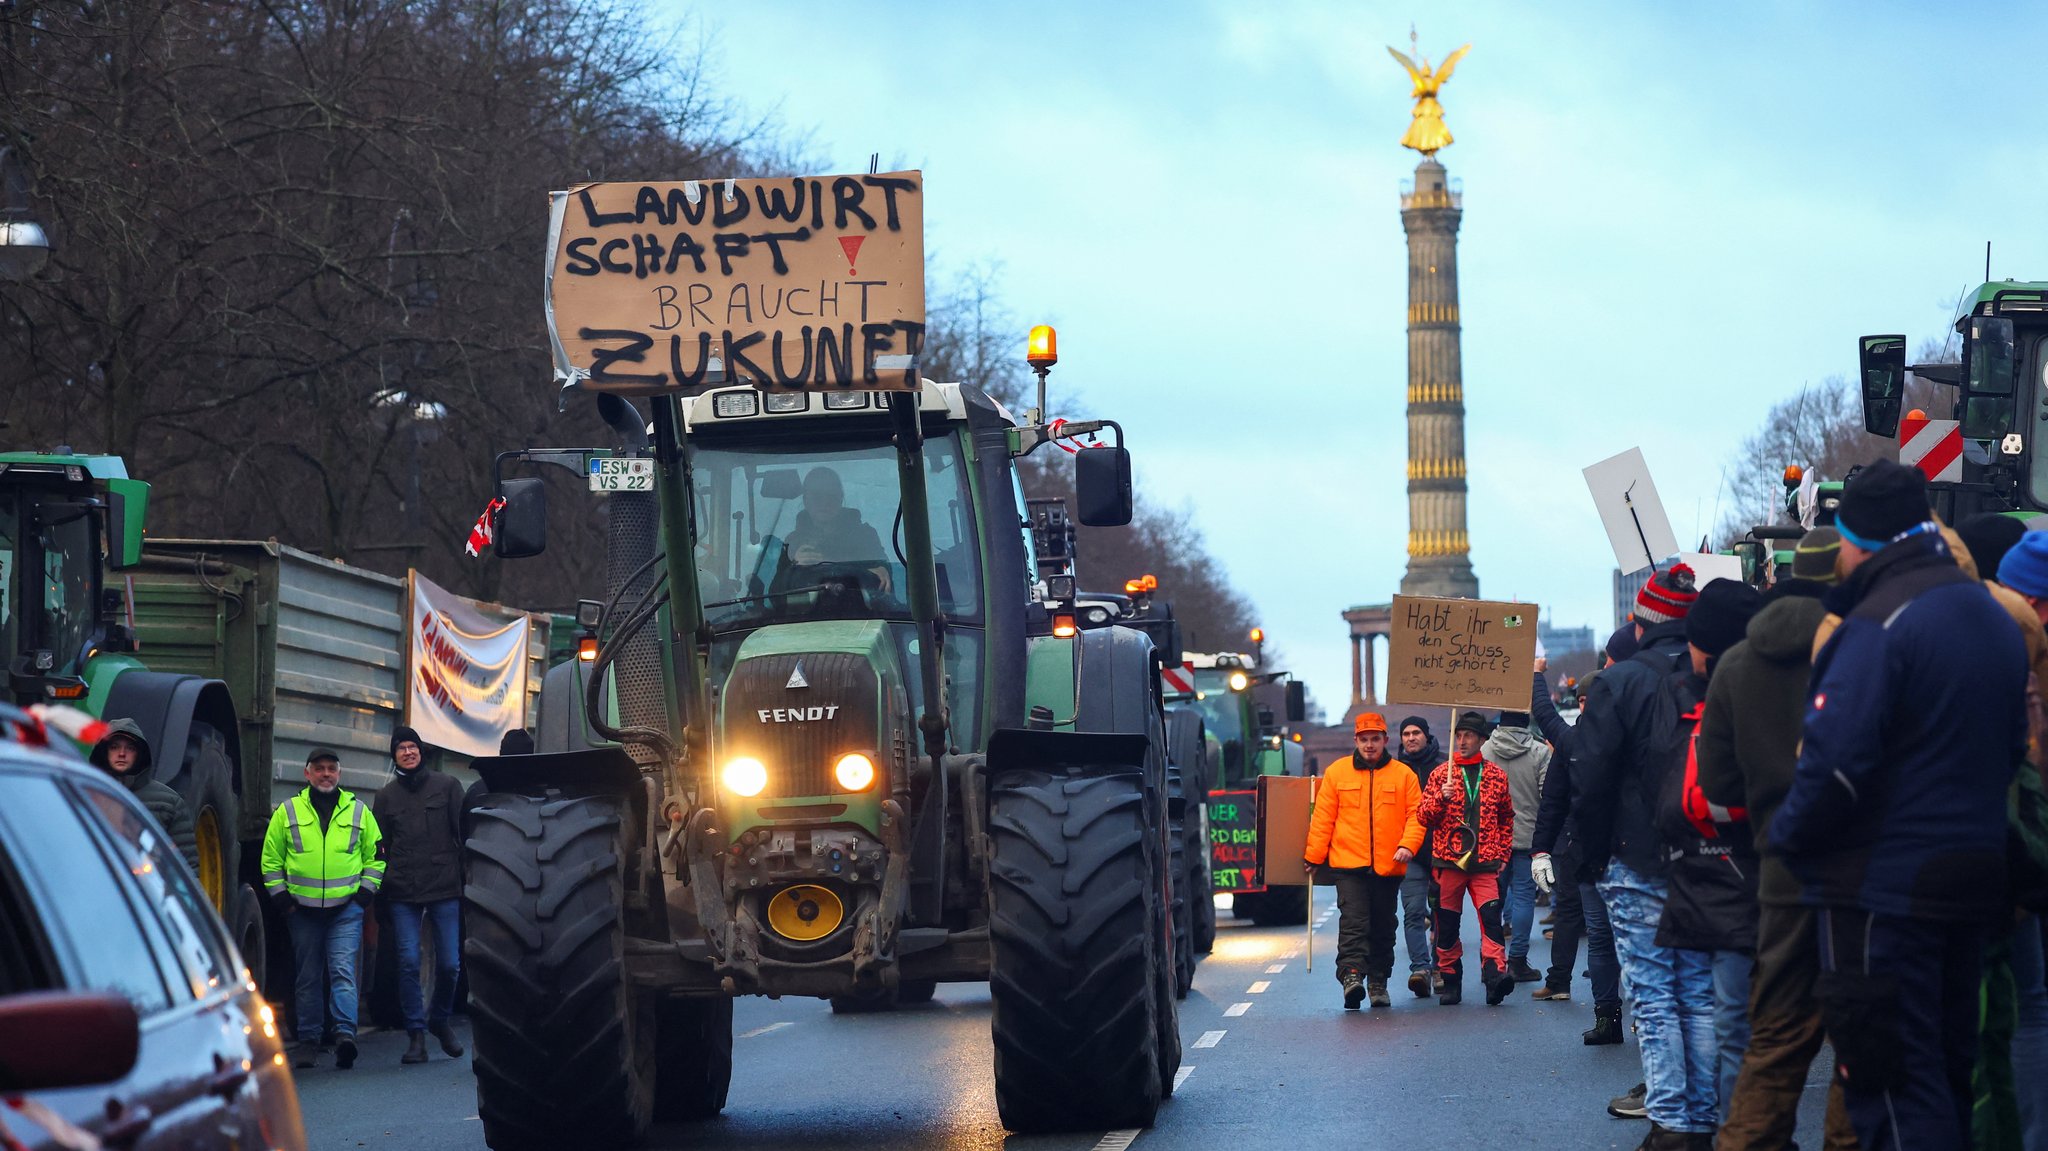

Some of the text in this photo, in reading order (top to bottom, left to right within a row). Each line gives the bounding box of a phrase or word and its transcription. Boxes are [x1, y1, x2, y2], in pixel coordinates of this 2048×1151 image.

[579, 176, 918, 232] LANDWIRT
[565, 226, 811, 279] SCHAFT
[649, 280, 888, 330] BRAUCHT
[579, 319, 925, 389] ZUKUNFT
[601, 461, 630, 474] ESW
[600, 476, 645, 489] VS 22
[1407, 603, 1451, 632] Habt
[1418, 632, 1503, 658] den Schuss
[1414, 655, 1443, 669] nicht
[757, 705, 839, 723] FENDT
